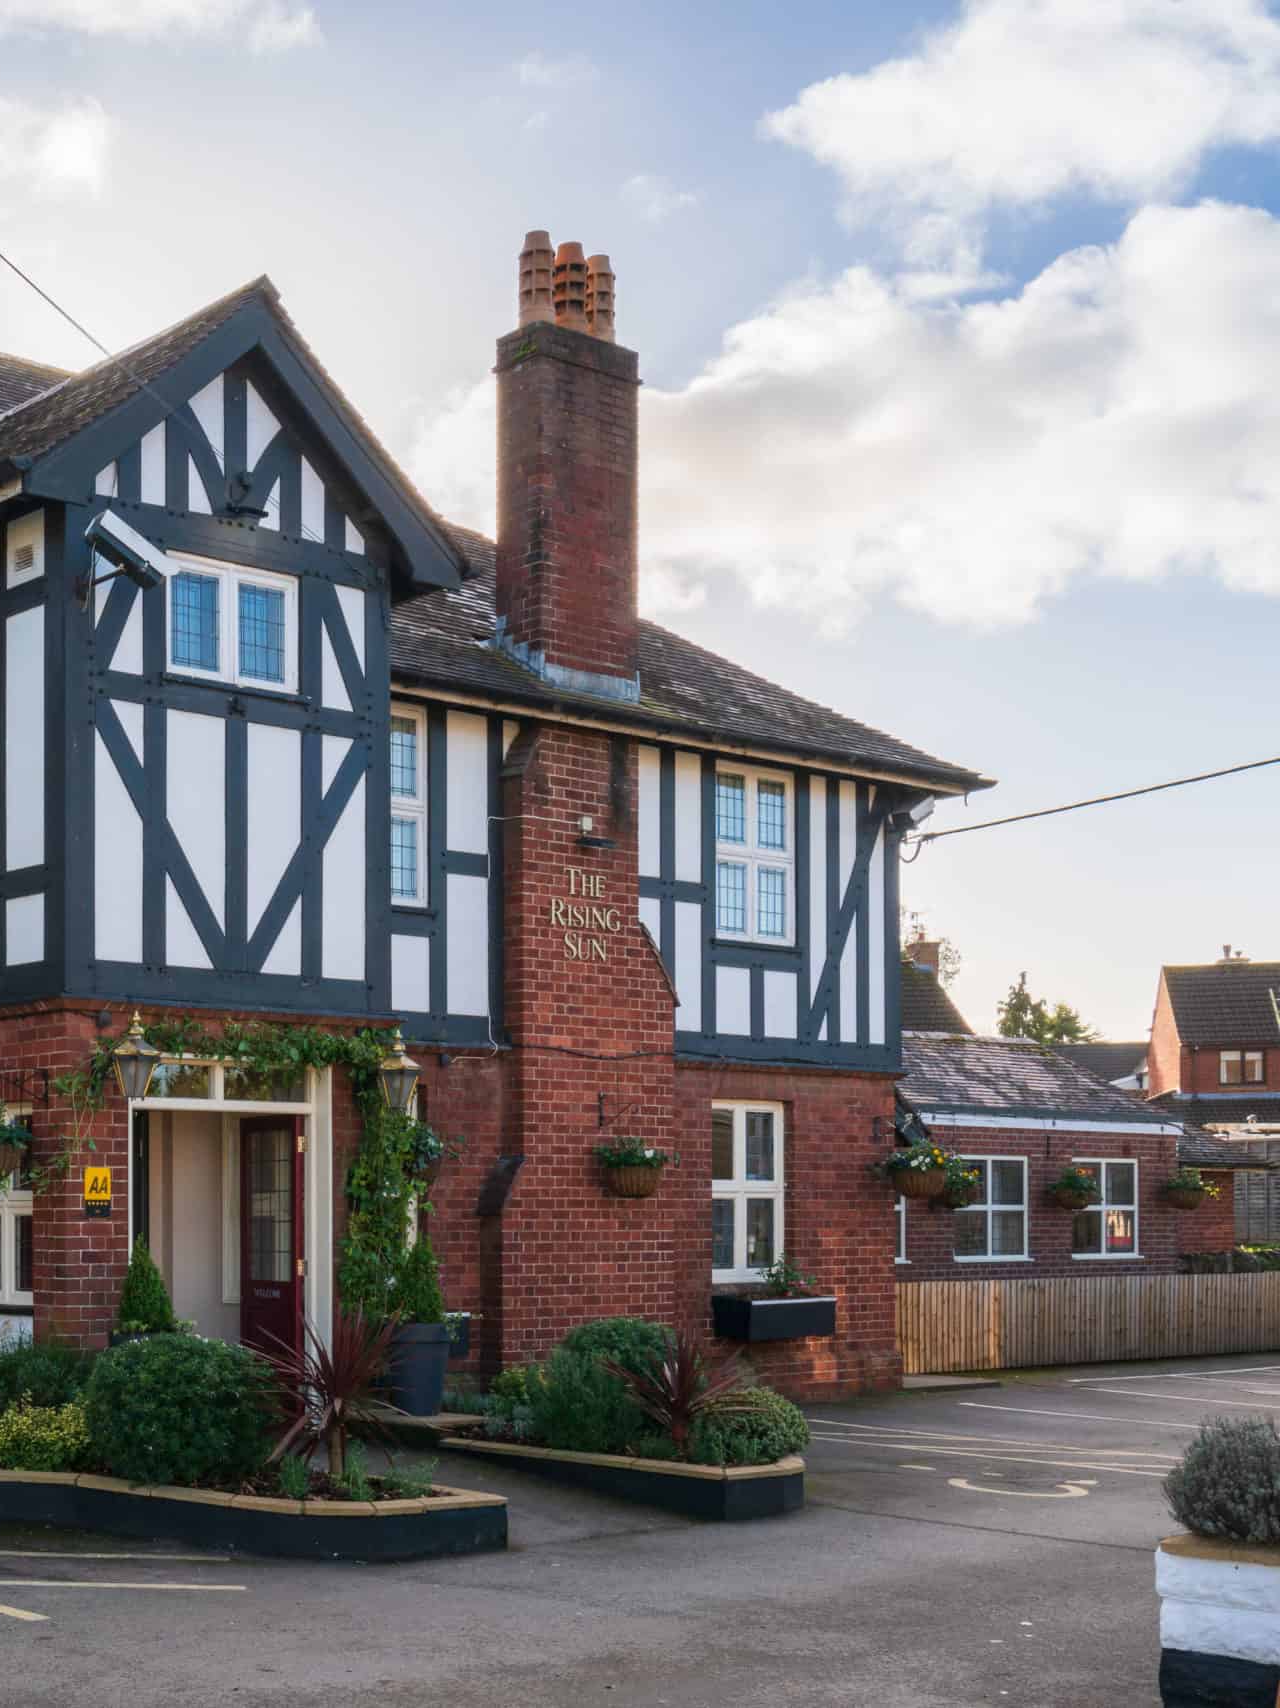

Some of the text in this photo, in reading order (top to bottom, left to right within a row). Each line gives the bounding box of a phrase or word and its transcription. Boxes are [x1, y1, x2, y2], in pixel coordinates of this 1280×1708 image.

[565, 868, 606, 897] THE
[551, 898, 620, 931] RISING
[564, 932, 606, 961] SUN
[88, 1175, 108, 1194] AA
